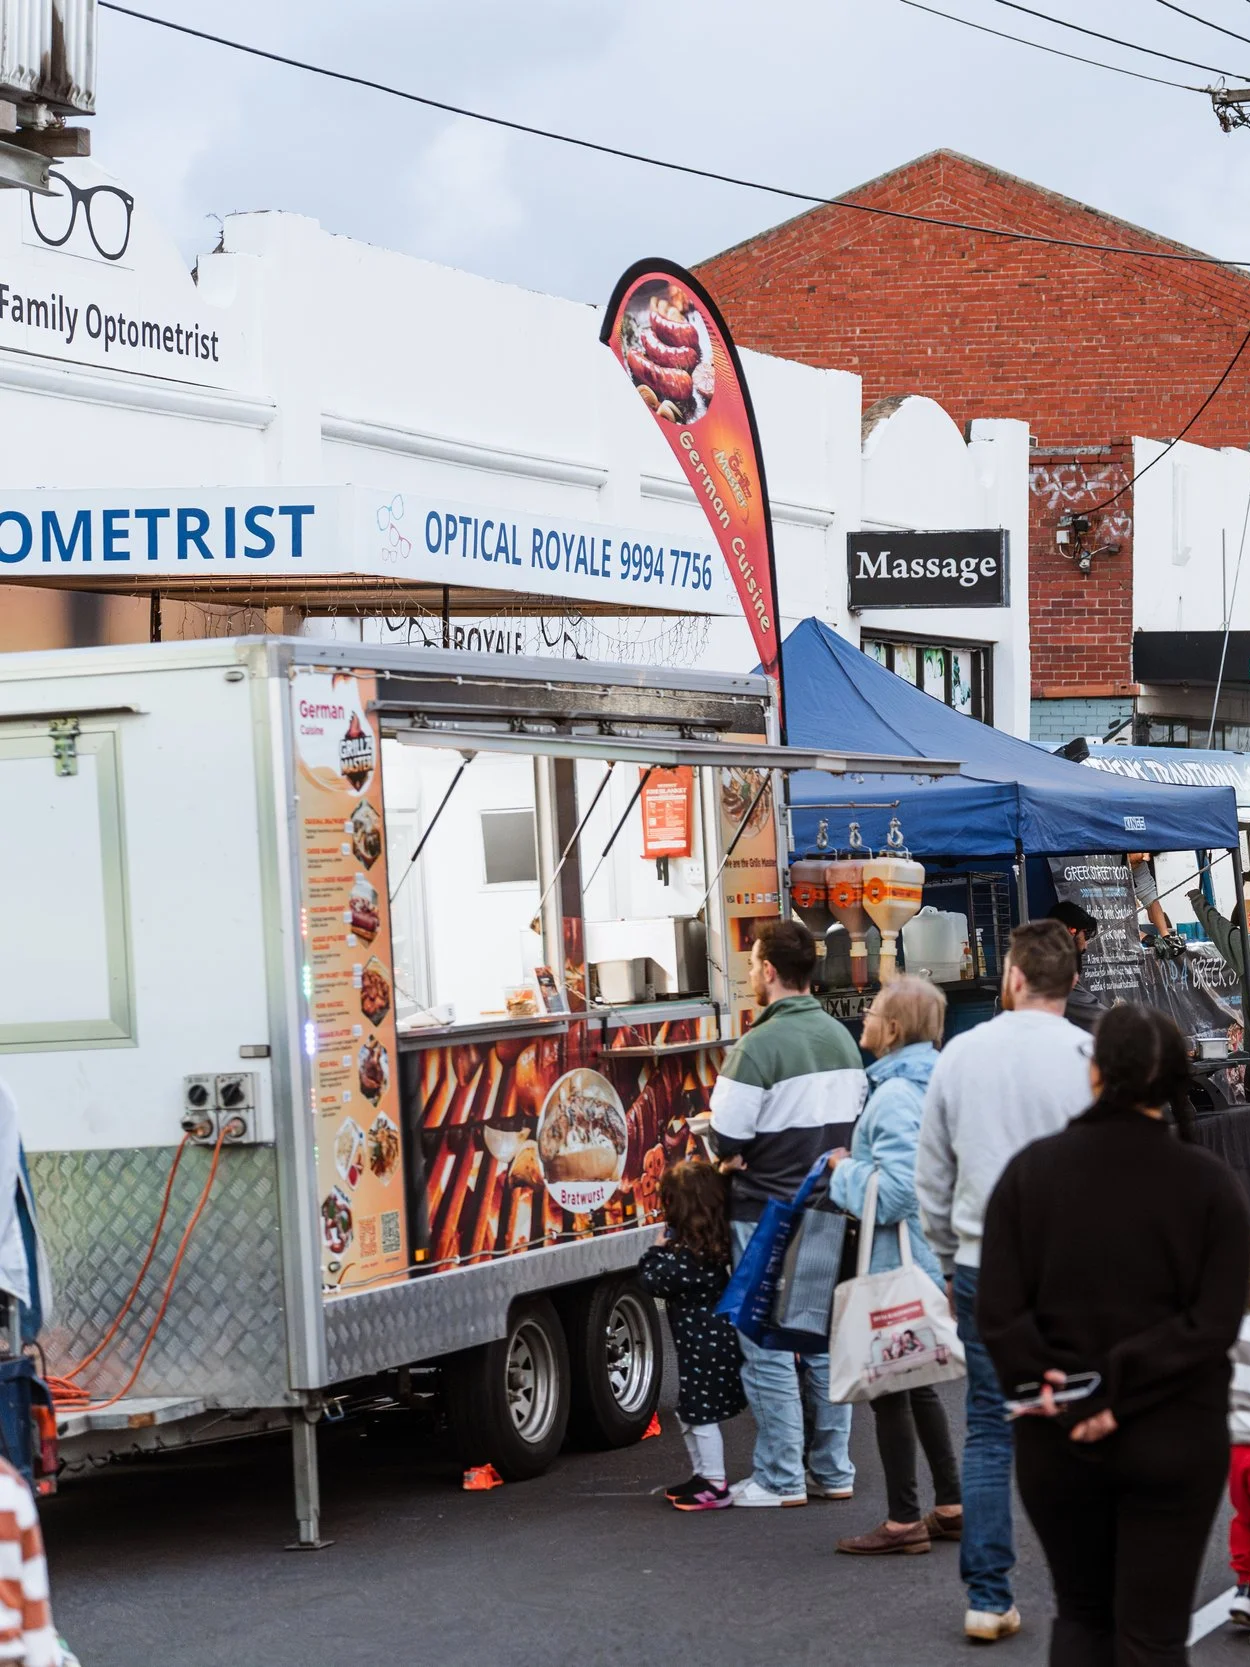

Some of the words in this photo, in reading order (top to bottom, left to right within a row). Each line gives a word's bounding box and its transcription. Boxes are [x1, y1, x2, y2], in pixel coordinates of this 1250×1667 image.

[0, 283, 78, 344] Family
[86, 303, 219, 362] Optometrist
[0, 505, 315, 563] OMETRIST
[425, 510, 522, 566] OPTICAL
[531, 527, 612, 578] ROYALE
[620, 541, 665, 584] 9994
[669, 549, 712, 591] 7756
[679, 430, 731, 529] German
[731, 537, 770, 633] Cuisine
[855, 551, 997, 587] Massage
[299, 700, 345, 719] German
[1191, 956, 1227, 990] GREEK
[560, 1186, 605, 1205] Bratwurst
